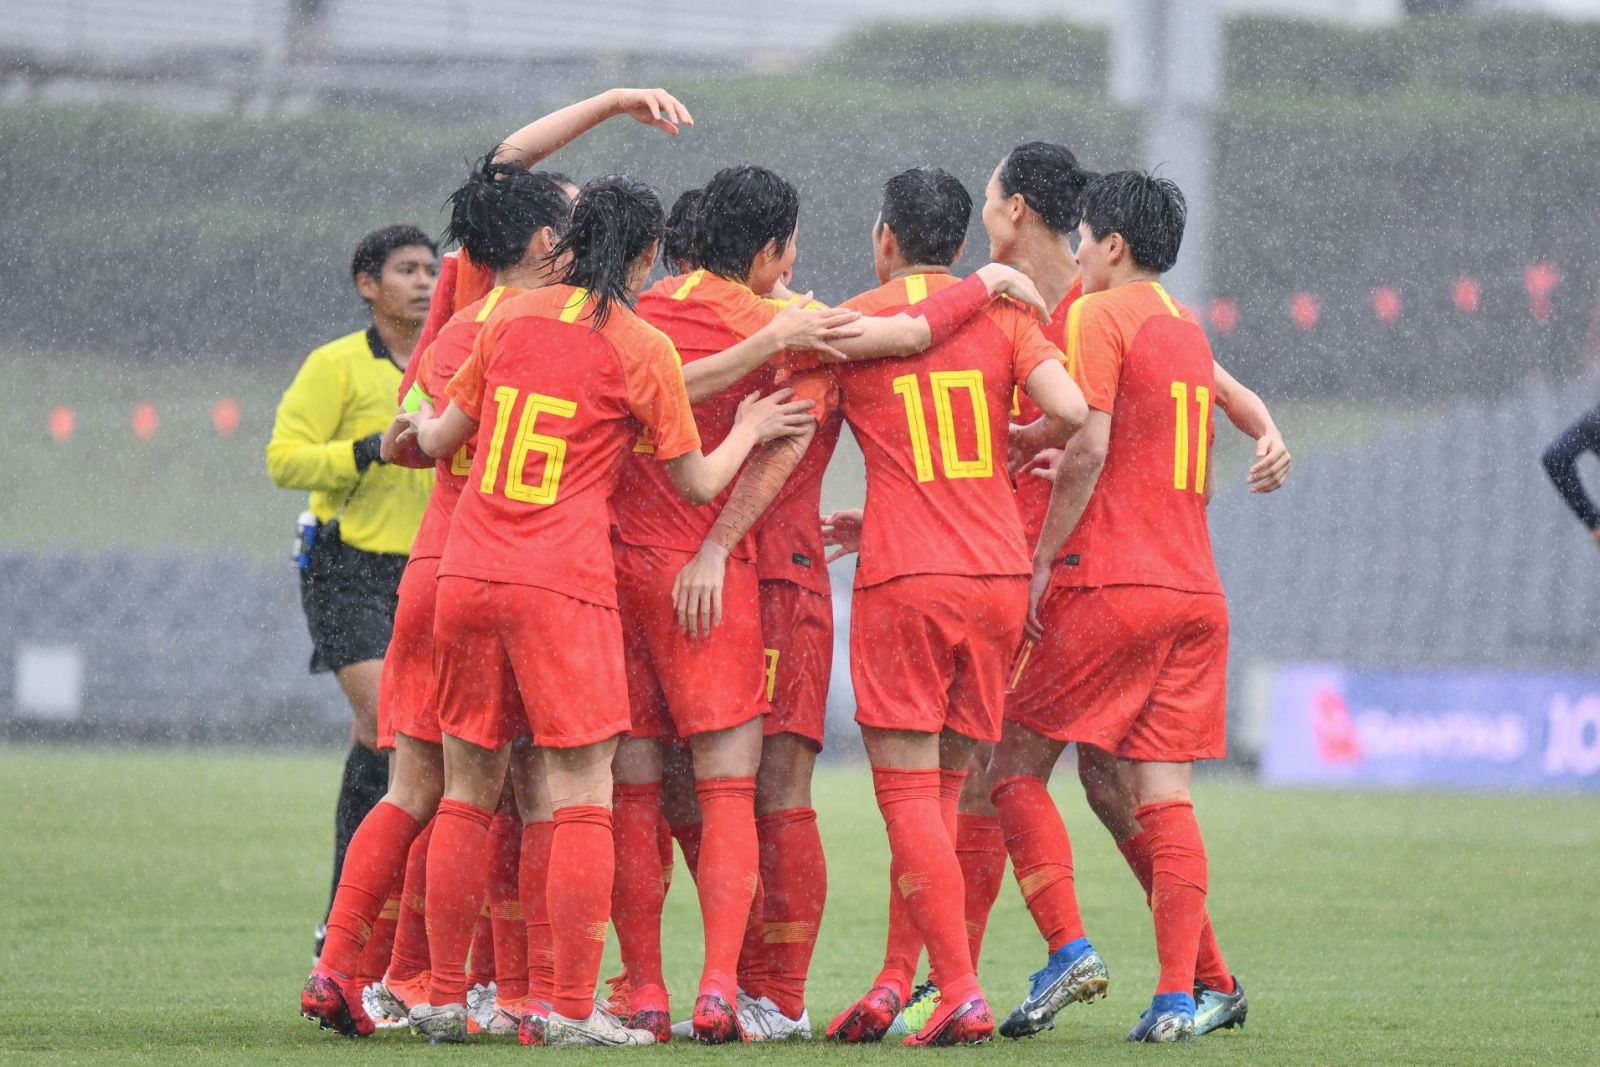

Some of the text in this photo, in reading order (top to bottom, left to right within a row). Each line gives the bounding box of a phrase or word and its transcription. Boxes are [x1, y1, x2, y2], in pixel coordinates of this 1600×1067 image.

[480, 386, 578, 505] 16
[893, 370, 993, 483] 10
[1170, 381, 1210, 494] 11
